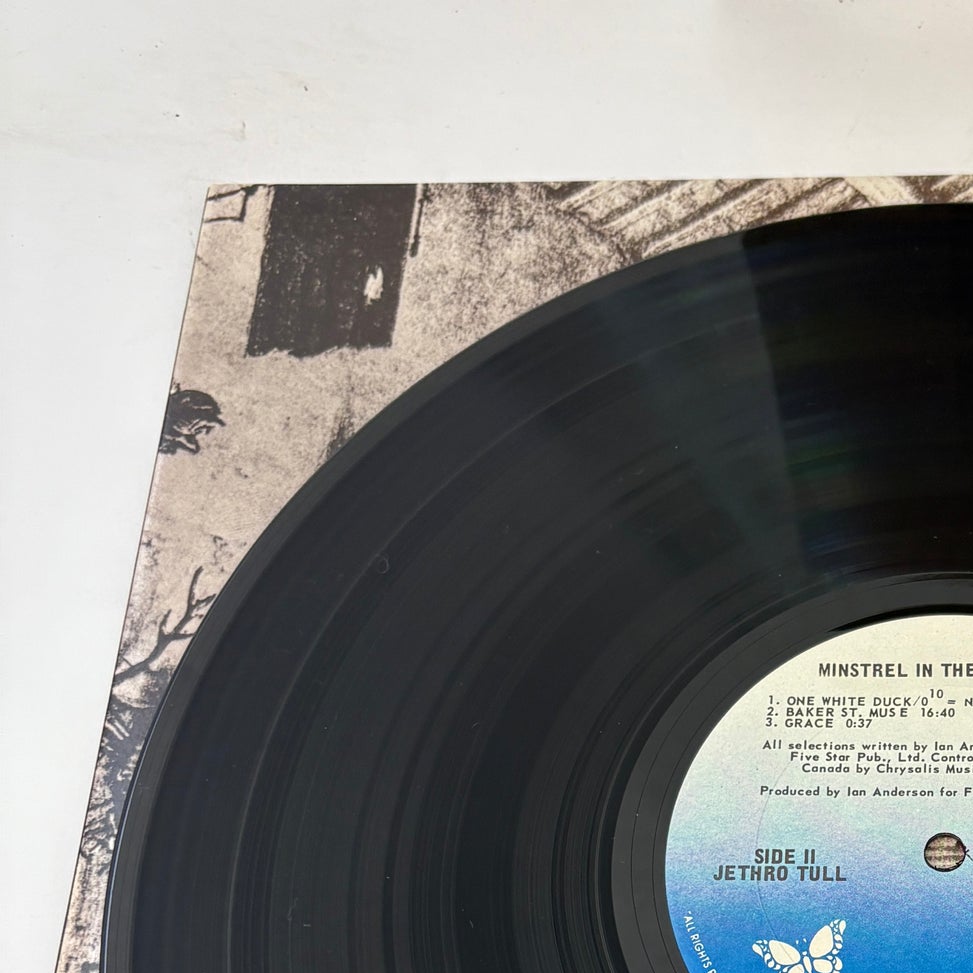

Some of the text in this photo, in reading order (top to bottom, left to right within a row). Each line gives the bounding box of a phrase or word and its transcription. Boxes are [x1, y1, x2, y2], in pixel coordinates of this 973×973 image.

[819, 663, 908, 677] MINSTREL
[916, 663, 933, 677] IN
[769, 695, 780, 705] 1.
[787, 696, 815, 706] ONE
[822, 697, 865, 706] WHITE
[767, 707, 955, 717] 2. BAKER ST. MUSE 16:40
[765, 718, 872, 728] 3. GRACE 0:37
[763, 740, 782, 749] All
[788, 740, 855, 750] selections
[862, 741, 907, 751] written
[914, 741, 927, 753] by
[935, 742, 953, 751] Ian
[790, 752, 819, 761] Five
[826, 752, 850, 762] Star
[857, 753, 891, 763] Pub.,
[898, 753, 925, 762] Ltd.
[802, 763, 850, 773] Canada
[856, 764, 870, 775] by
[877, 764, 939, 775] Chrysalis
[760, 786, 820, 796] Produced
[826, 786, 840, 797] by
[847, 787, 866, 796] Ian
[873, 787, 934, 797] Anderson
[940, 787, 957, 797] for
[754, 849, 815, 864] SIDE II
[713, 865, 846, 881] JETHRO TULL
[690, 933, 712, 969] RIGHTS
